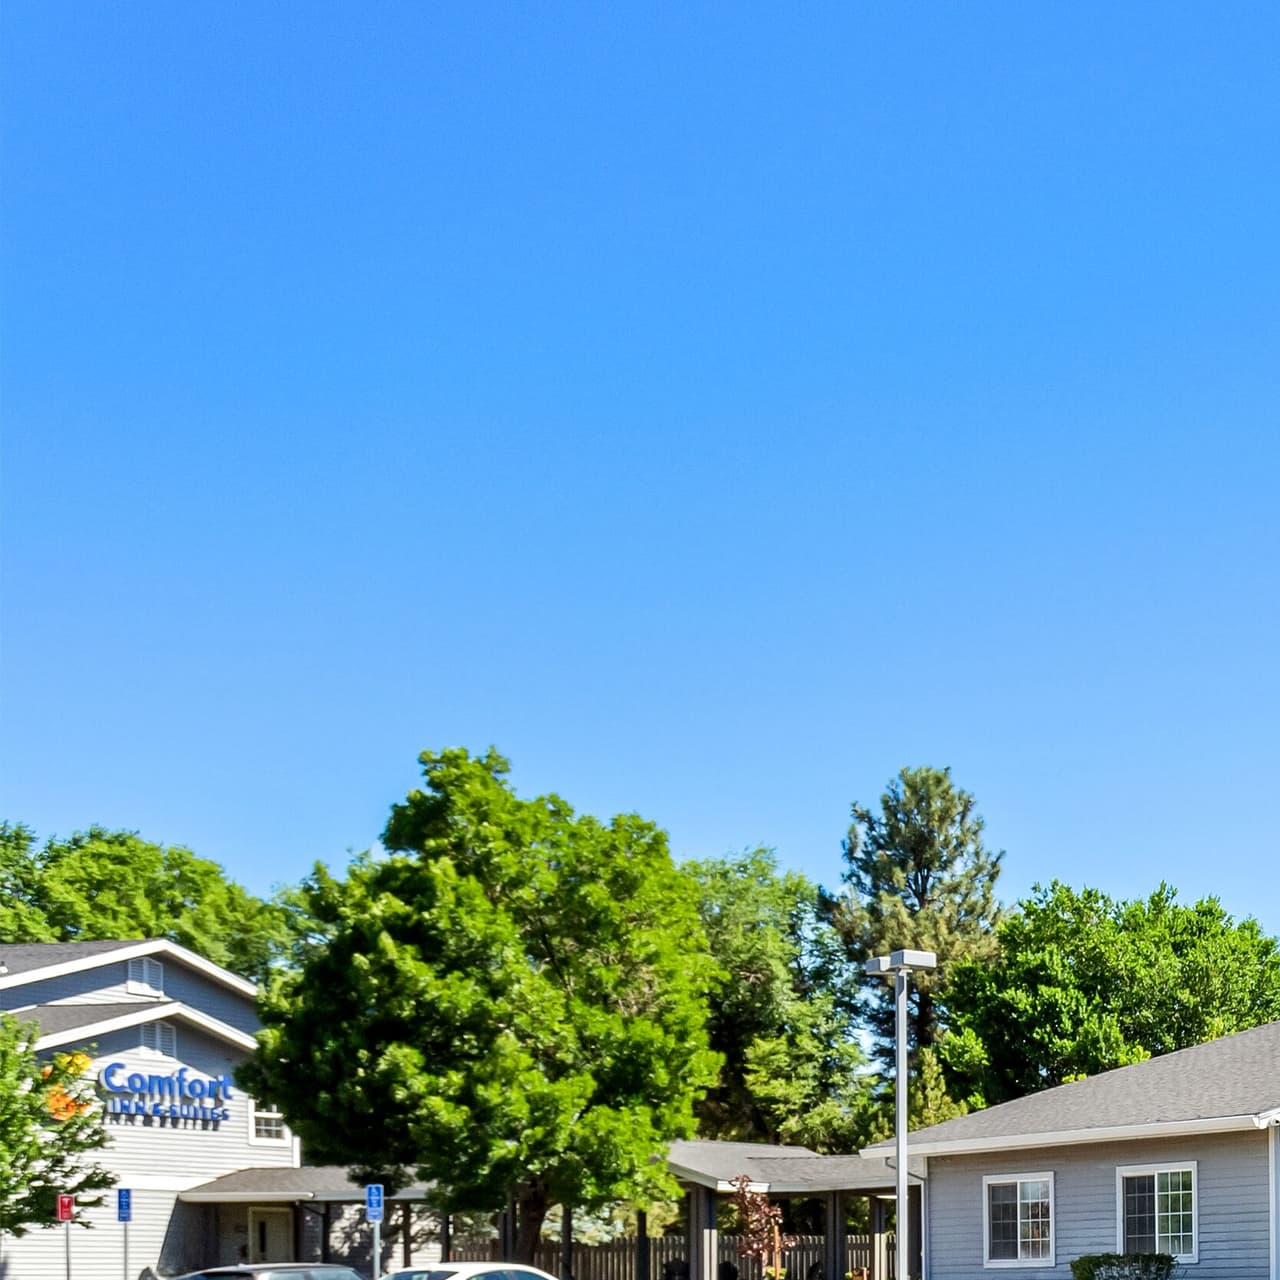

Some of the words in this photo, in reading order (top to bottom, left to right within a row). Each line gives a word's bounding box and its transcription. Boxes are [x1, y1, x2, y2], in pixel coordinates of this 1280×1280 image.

[102, 1062, 233, 1100] Comfort
[111, 1098, 146, 1115] INN
[169, 1104, 230, 1121] SUITES
